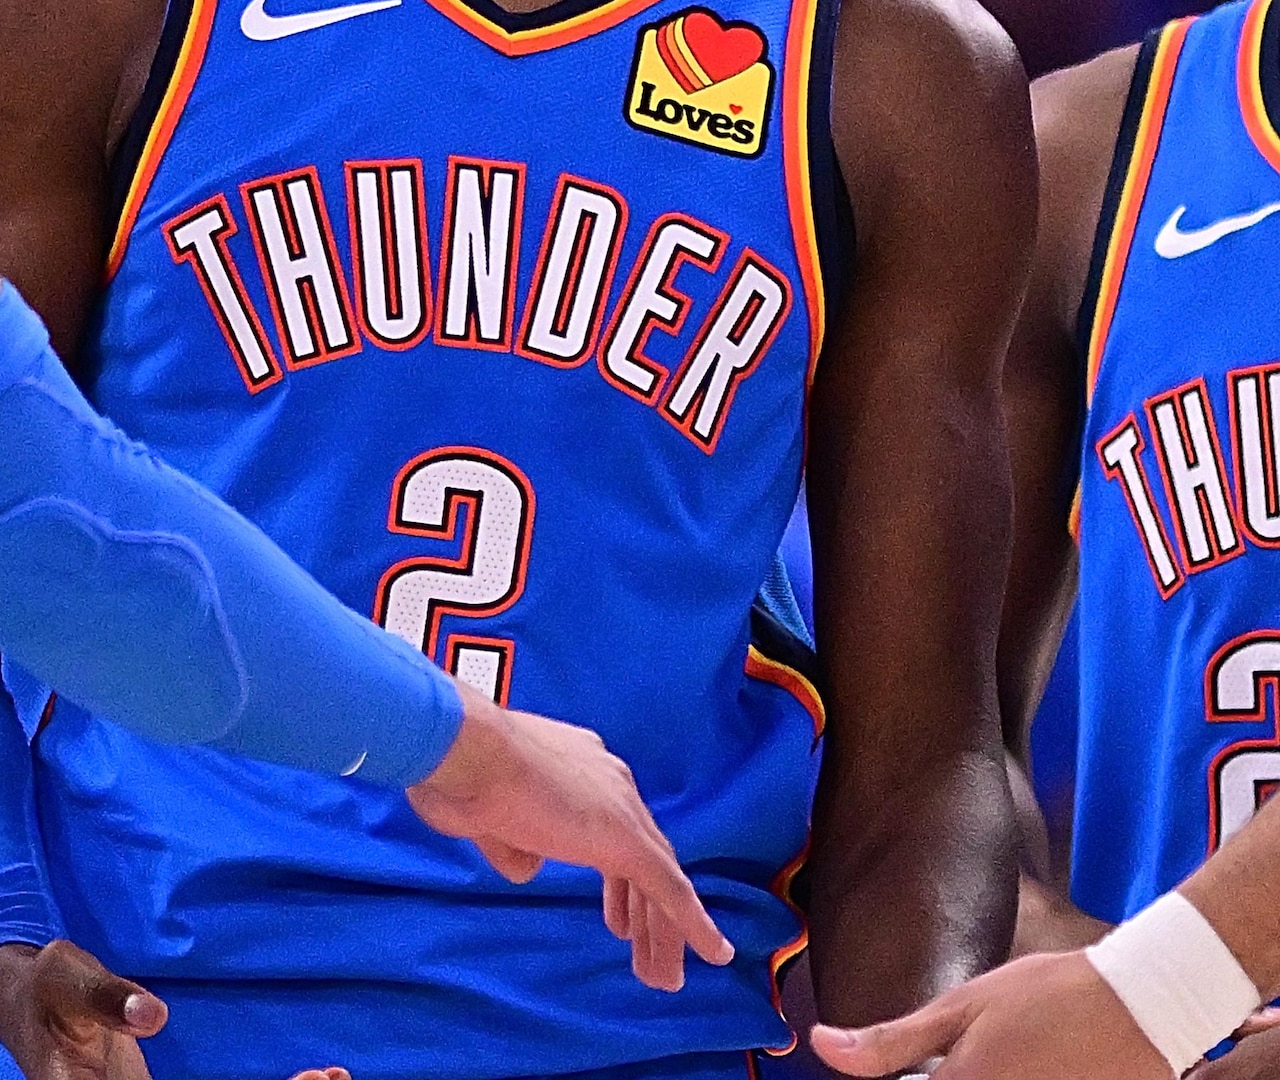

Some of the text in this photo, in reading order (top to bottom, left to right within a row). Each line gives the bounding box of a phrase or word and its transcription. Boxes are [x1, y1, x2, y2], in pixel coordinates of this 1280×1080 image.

[635, 81, 755, 144] Loves
[164, 156, 794, 455] THUNDER
[373, 447, 537, 708] 2
